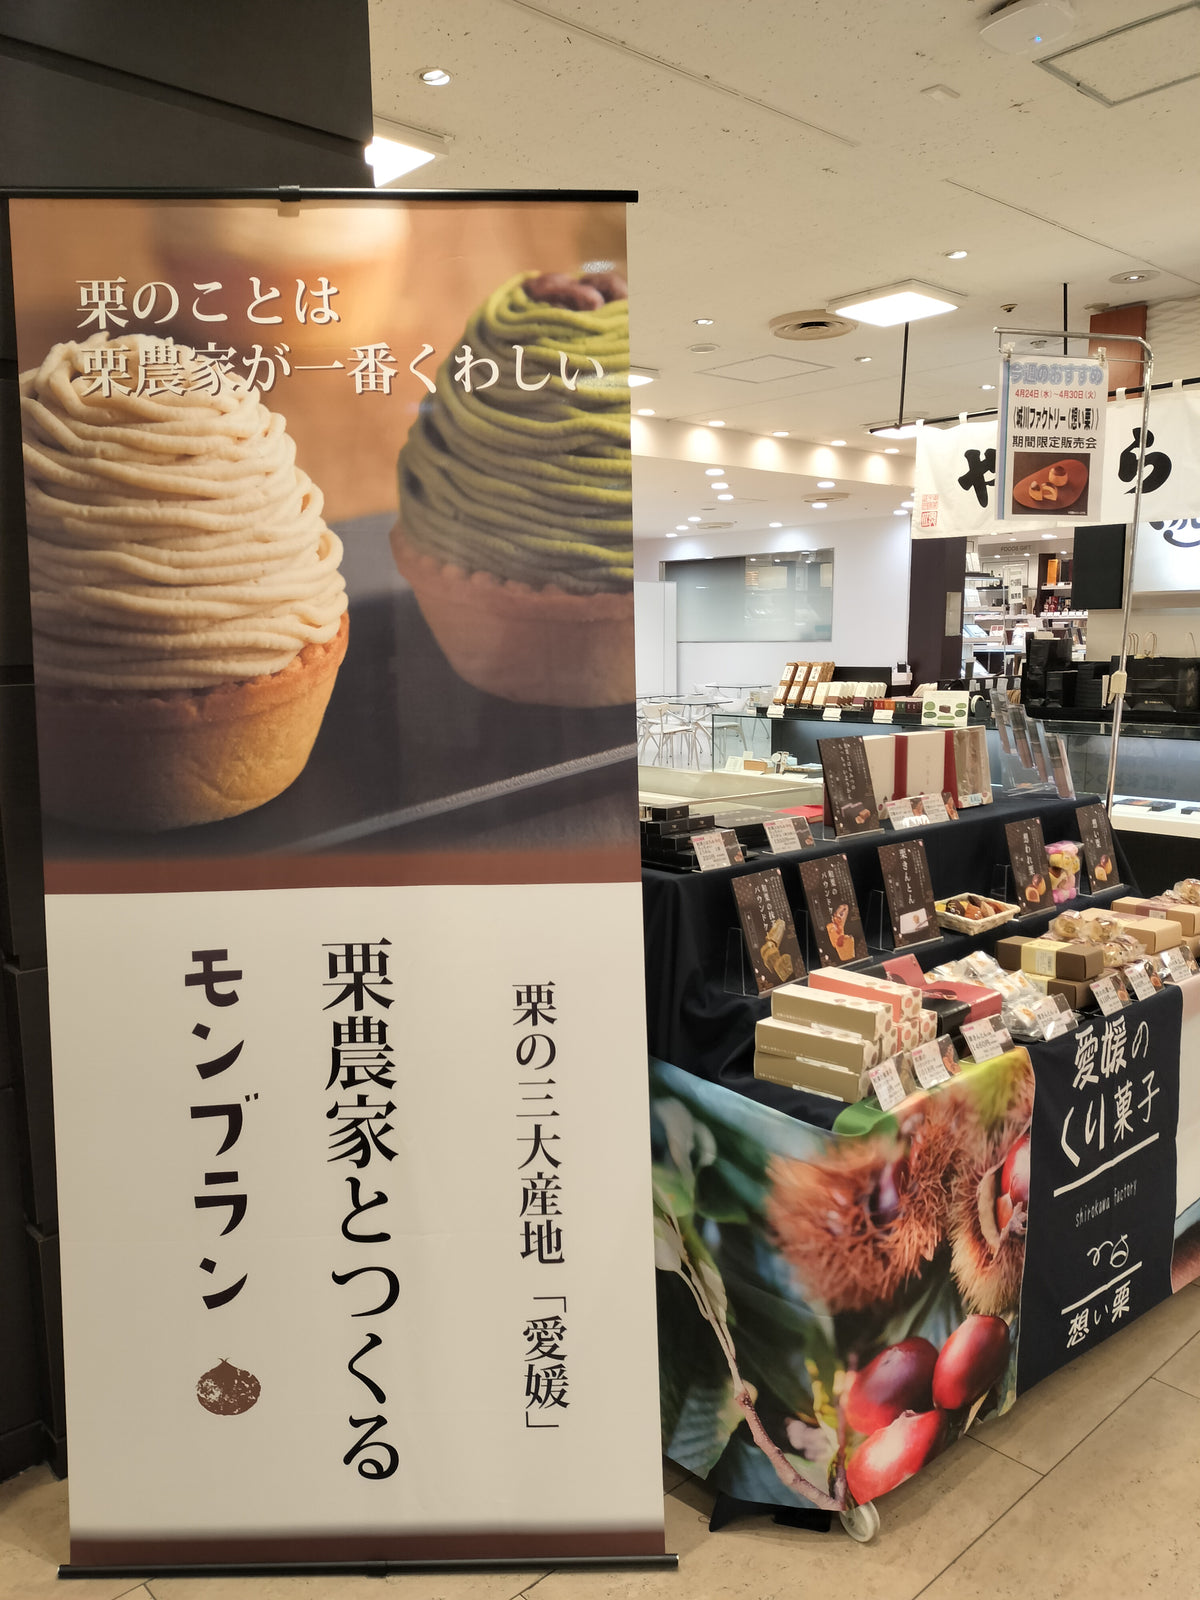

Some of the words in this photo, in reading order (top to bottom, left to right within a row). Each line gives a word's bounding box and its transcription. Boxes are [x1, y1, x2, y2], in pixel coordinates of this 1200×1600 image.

[76, 276, 340, 330] 栗のことは
[80, 342, 604, 397] 栗農家が一番くわしい
[1010, 362, 1104, 386] 今週のおすすめ
[1012, 435, 1097, 449] 期間限定販売会
[898, 848, 916, 905] 栗きんとん
[1072, 1014, 1150, 1091] 愛媛の
[184, 948, 260, 1310] モンブラン
[1060, 1070, 1161, 1168] くり菓子
[321, 937, 401, 1480] 栗農家とつくる
[511, 980, 571, 1428] 栗の三大産地「愛媛」
[1074, 1201, 1111, 1228] shirokawa
[1113, 1179, 1138, 1207] factory
[1066, 1280, 1131, 1349] 想い栗
